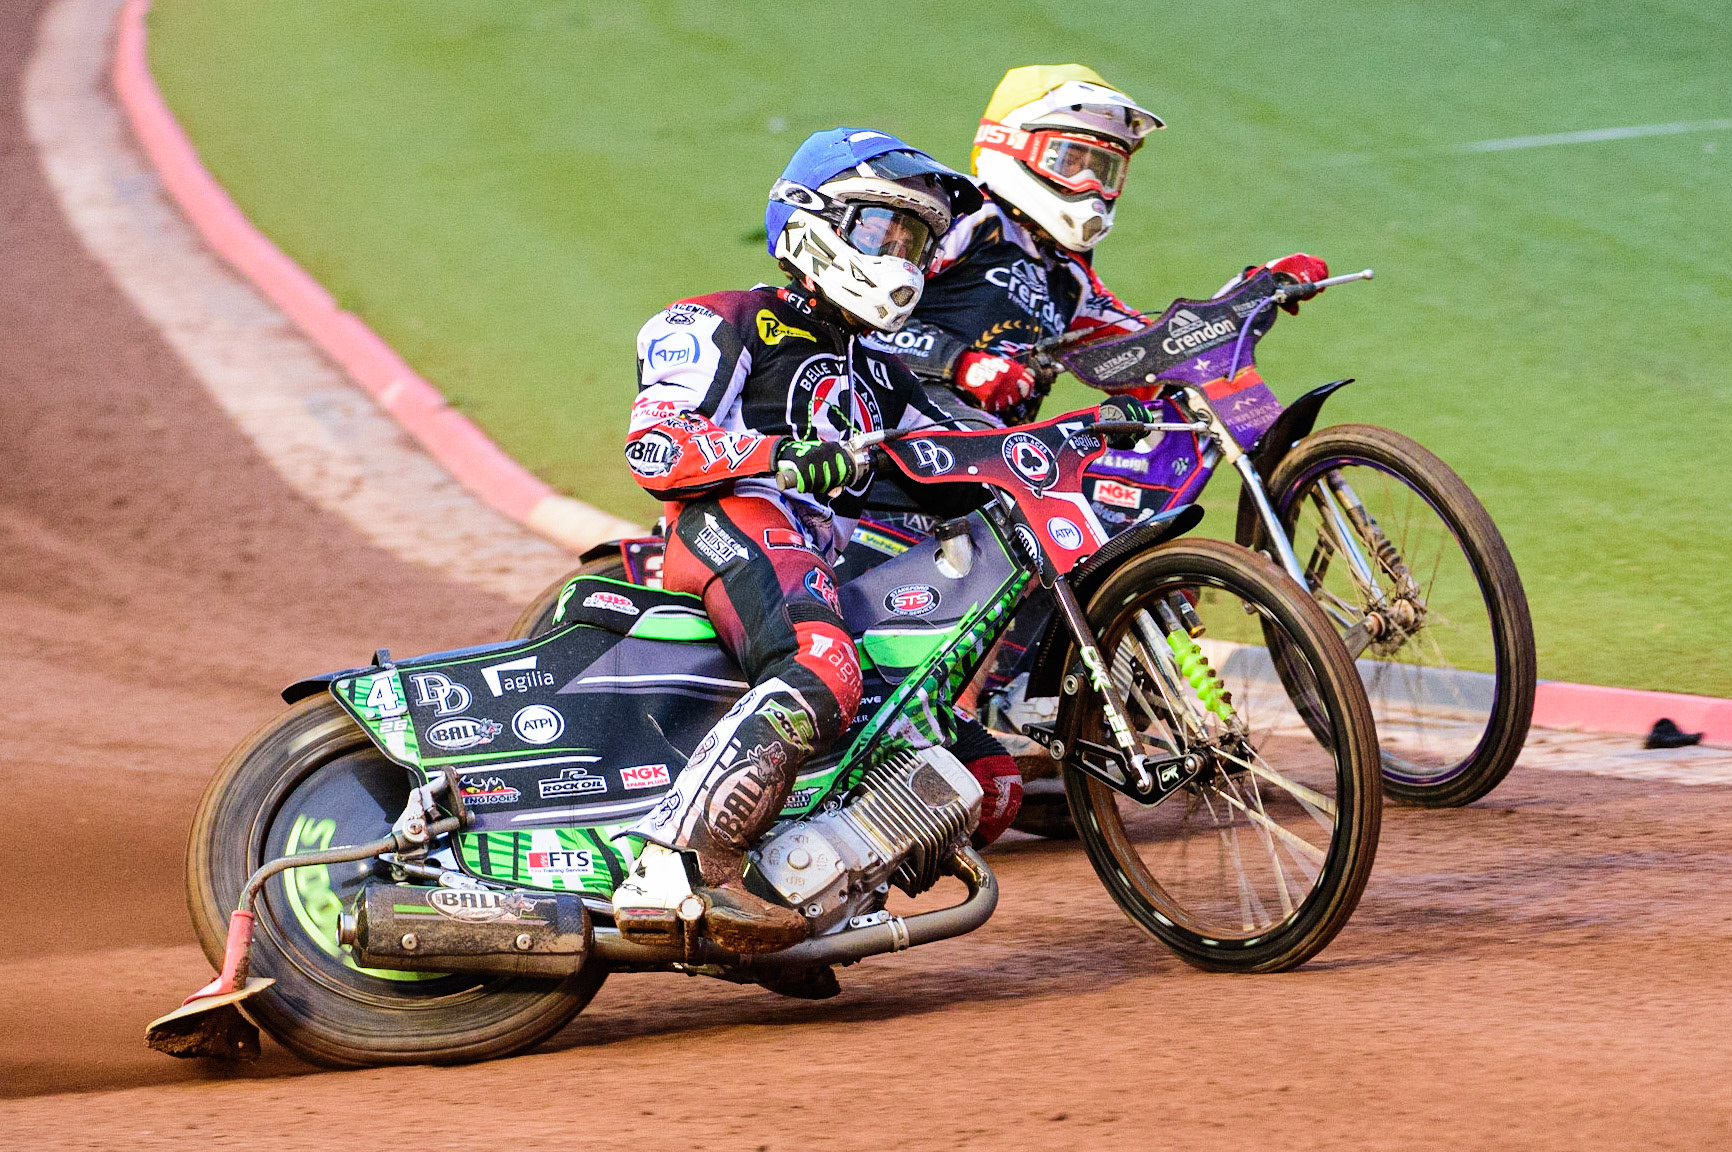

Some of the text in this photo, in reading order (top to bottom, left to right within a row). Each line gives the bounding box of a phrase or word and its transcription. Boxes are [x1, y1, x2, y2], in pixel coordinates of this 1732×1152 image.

[1162, 318, 1237, 356] Crendon
[800, 362, 831, 391] BELLE
[1073, 434, 1100, 451] agilia
[1098, 483, 1137, 501] NGK
[1055, 527, 1076, 539] ATPI
[894, 592, 930, 607] STS
[503, 670, 555, 693] agilia
[366, 676, 400, 711] 4
[379, 719, 408, 734] 26
[523, 718, 553, 731] ATPI
[436, 724, 480, 742] BALL
[622, 766, 667, 781] NGK
[543, 782, 579, 792] ROCK
[647, 778, 669, 786] PLUGS
[549, 851, 590, 867] FTS
[441, 892, 502, 909] BALL
